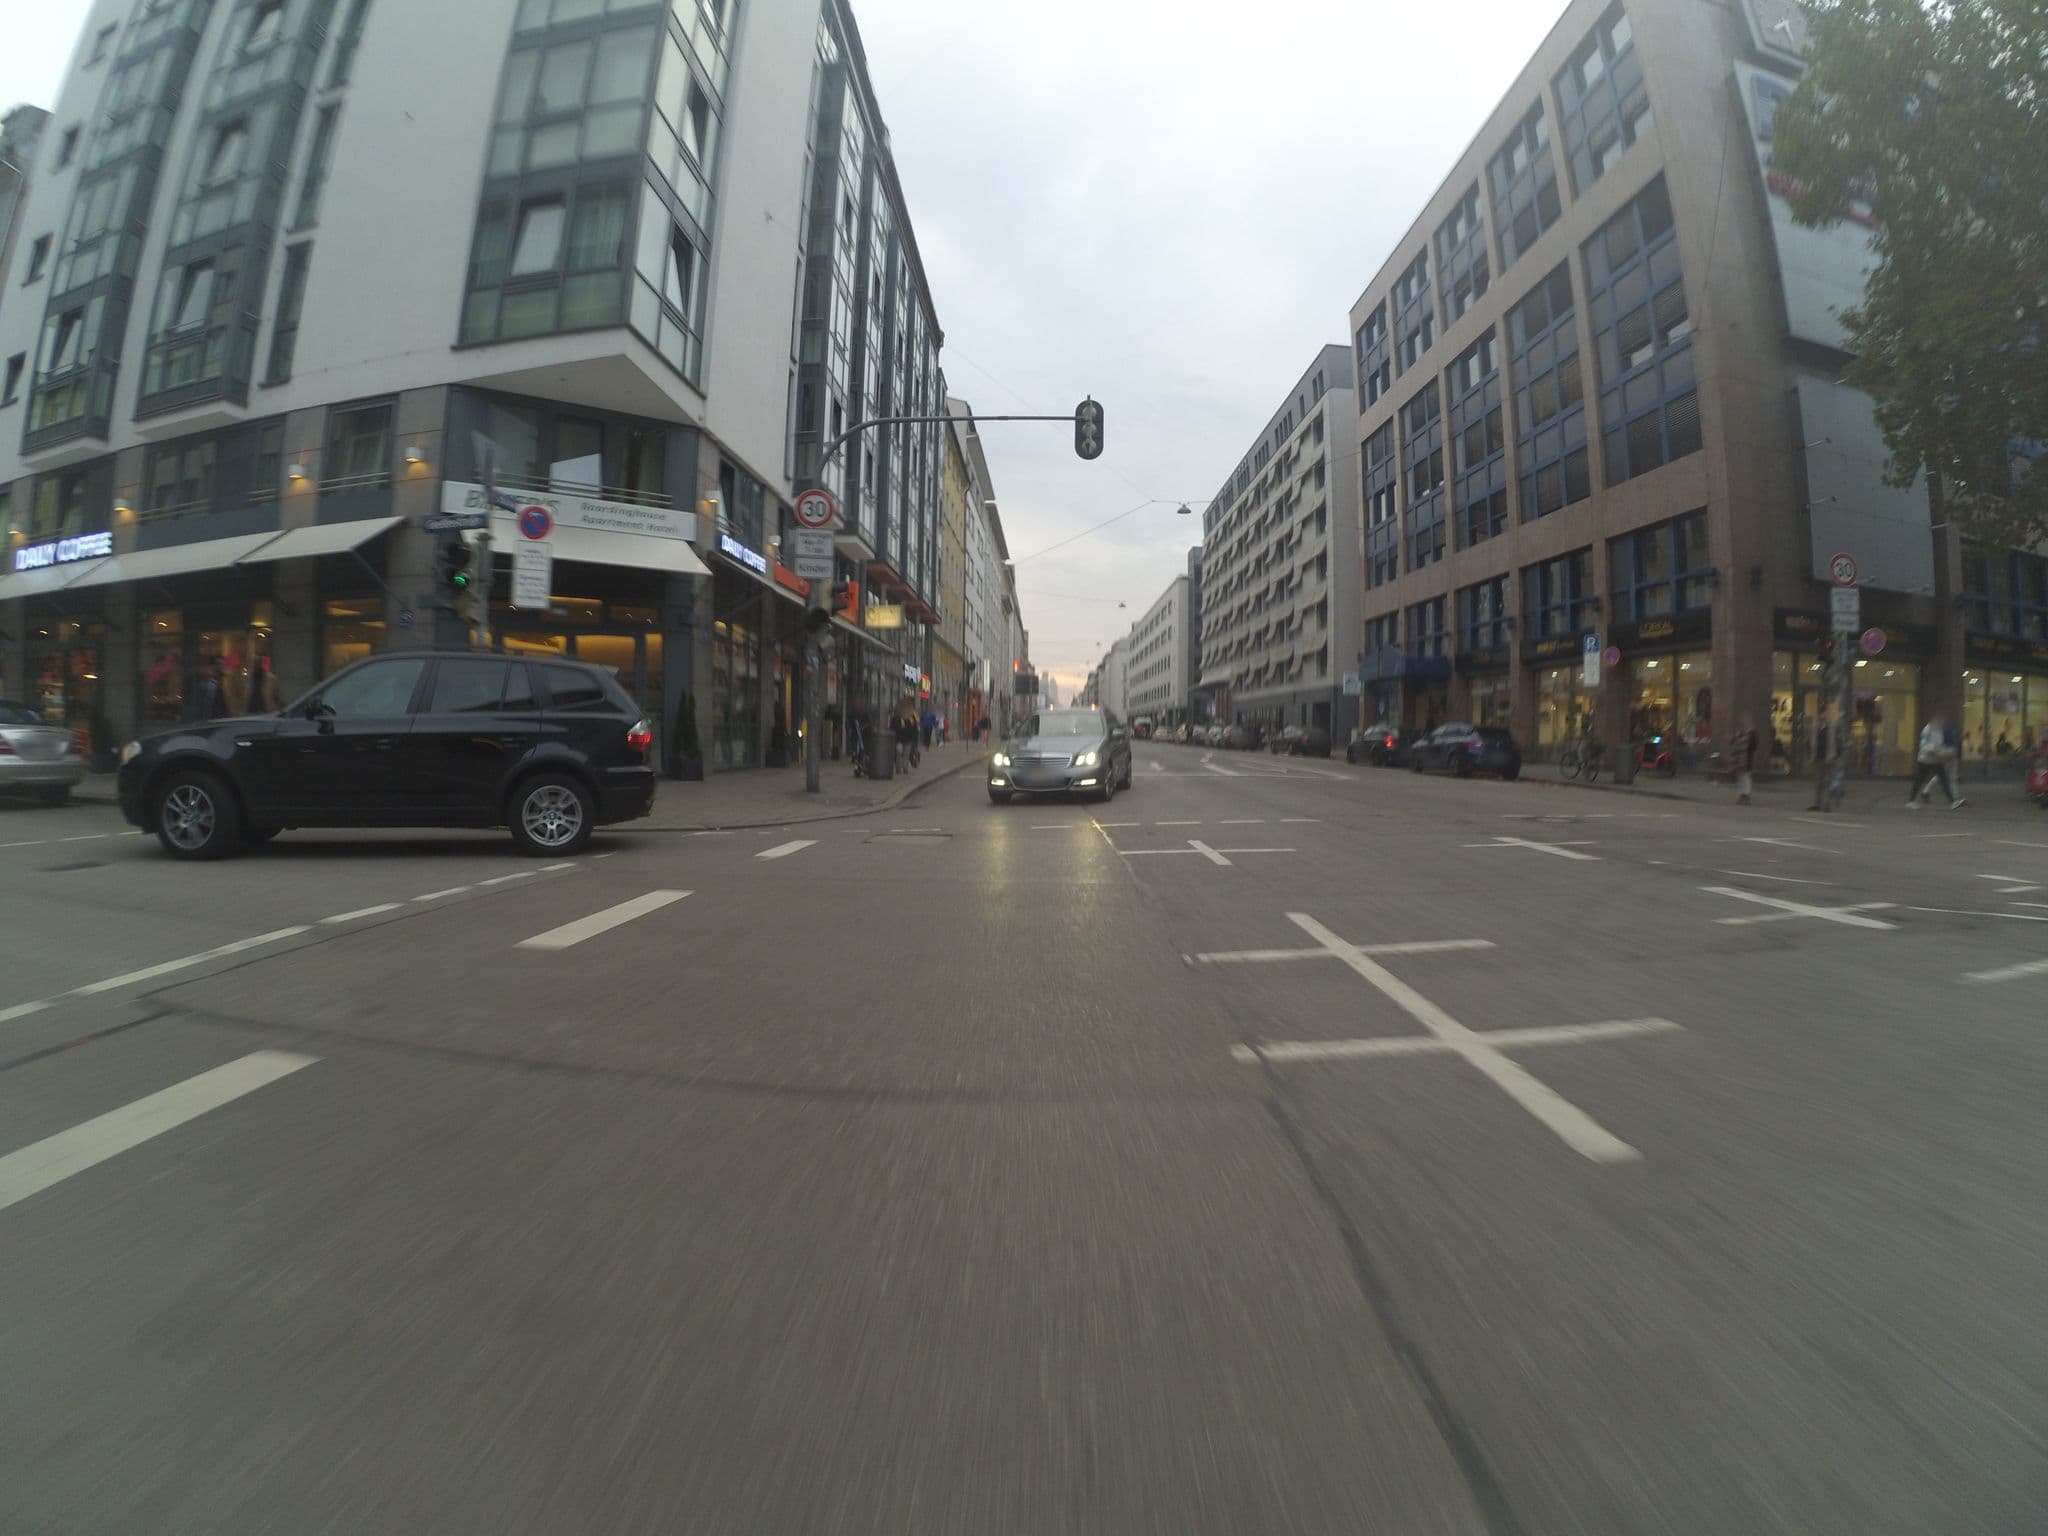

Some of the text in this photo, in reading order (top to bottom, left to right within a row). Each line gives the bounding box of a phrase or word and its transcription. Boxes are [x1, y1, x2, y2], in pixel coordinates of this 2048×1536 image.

[803, 500, 827, 517] 30
[15, 543, 57, 570] DAILY
[1835, 562, 1853, 578] 30
